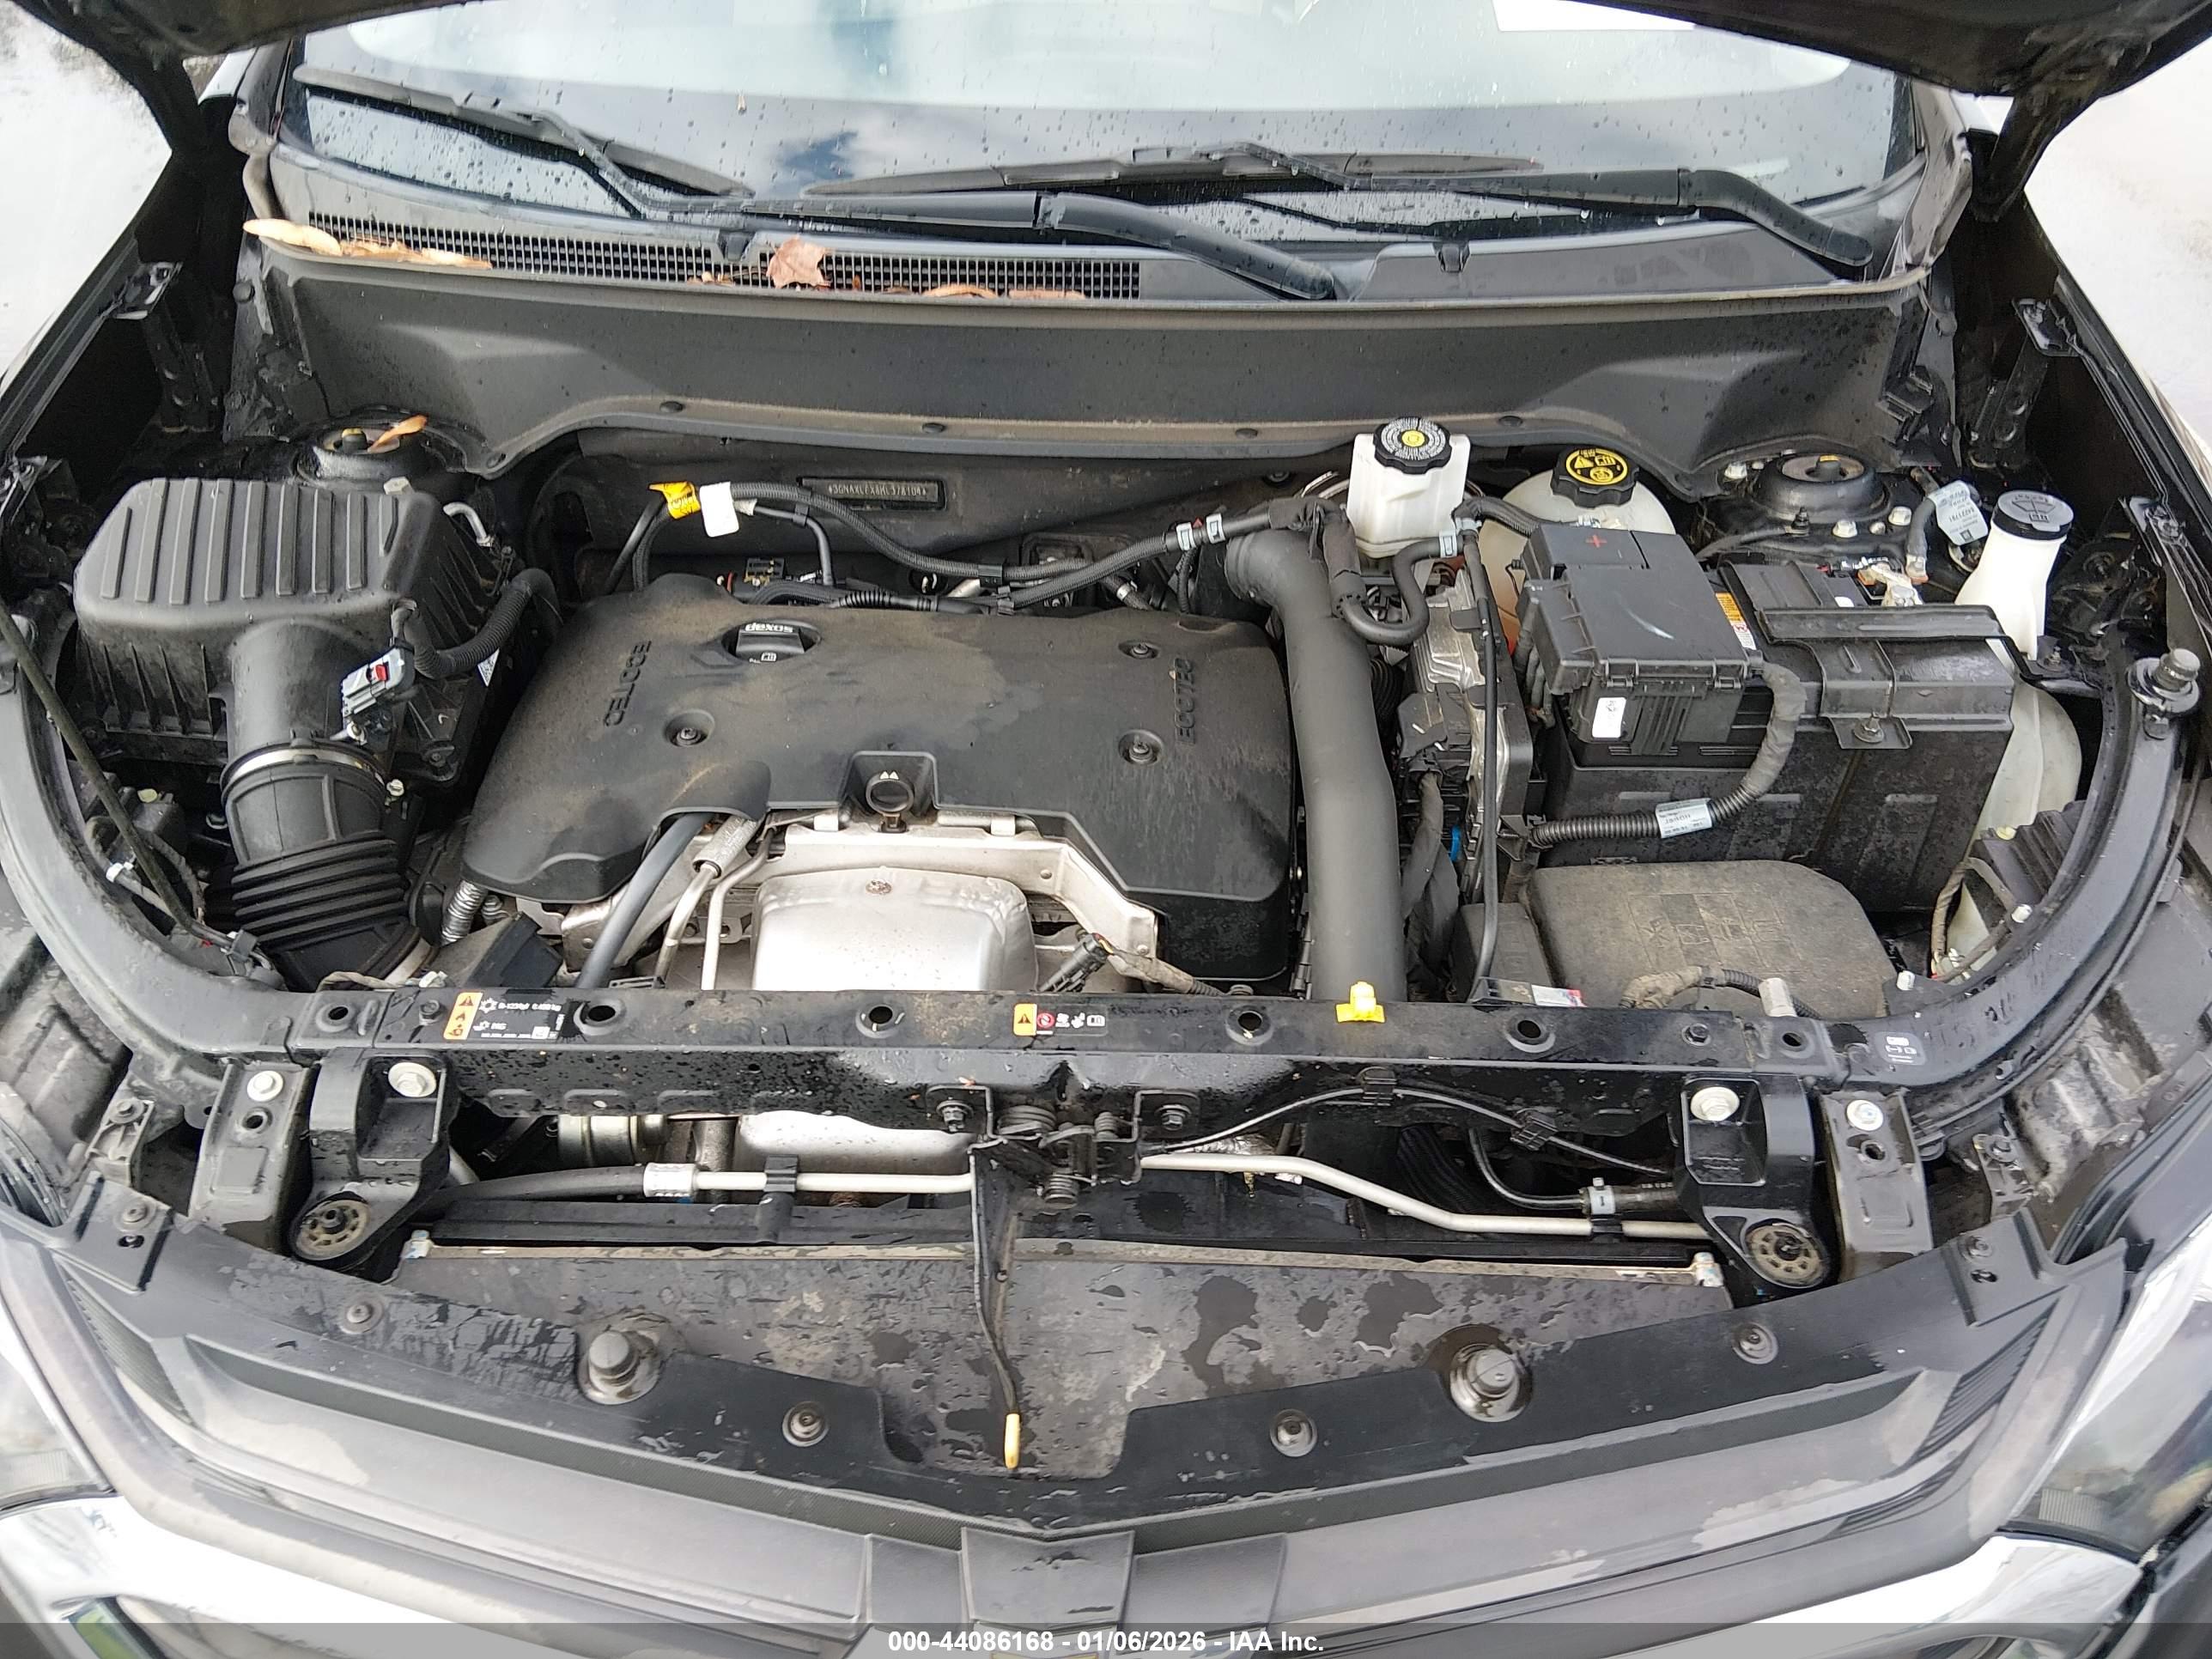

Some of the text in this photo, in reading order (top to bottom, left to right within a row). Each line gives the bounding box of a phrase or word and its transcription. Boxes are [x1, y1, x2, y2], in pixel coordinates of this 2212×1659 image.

[744, 622, 794, 634] dexos
[604, 640, 653, 727] ECOTEC
[1174, 657, 1196, 744] ECOTEC
